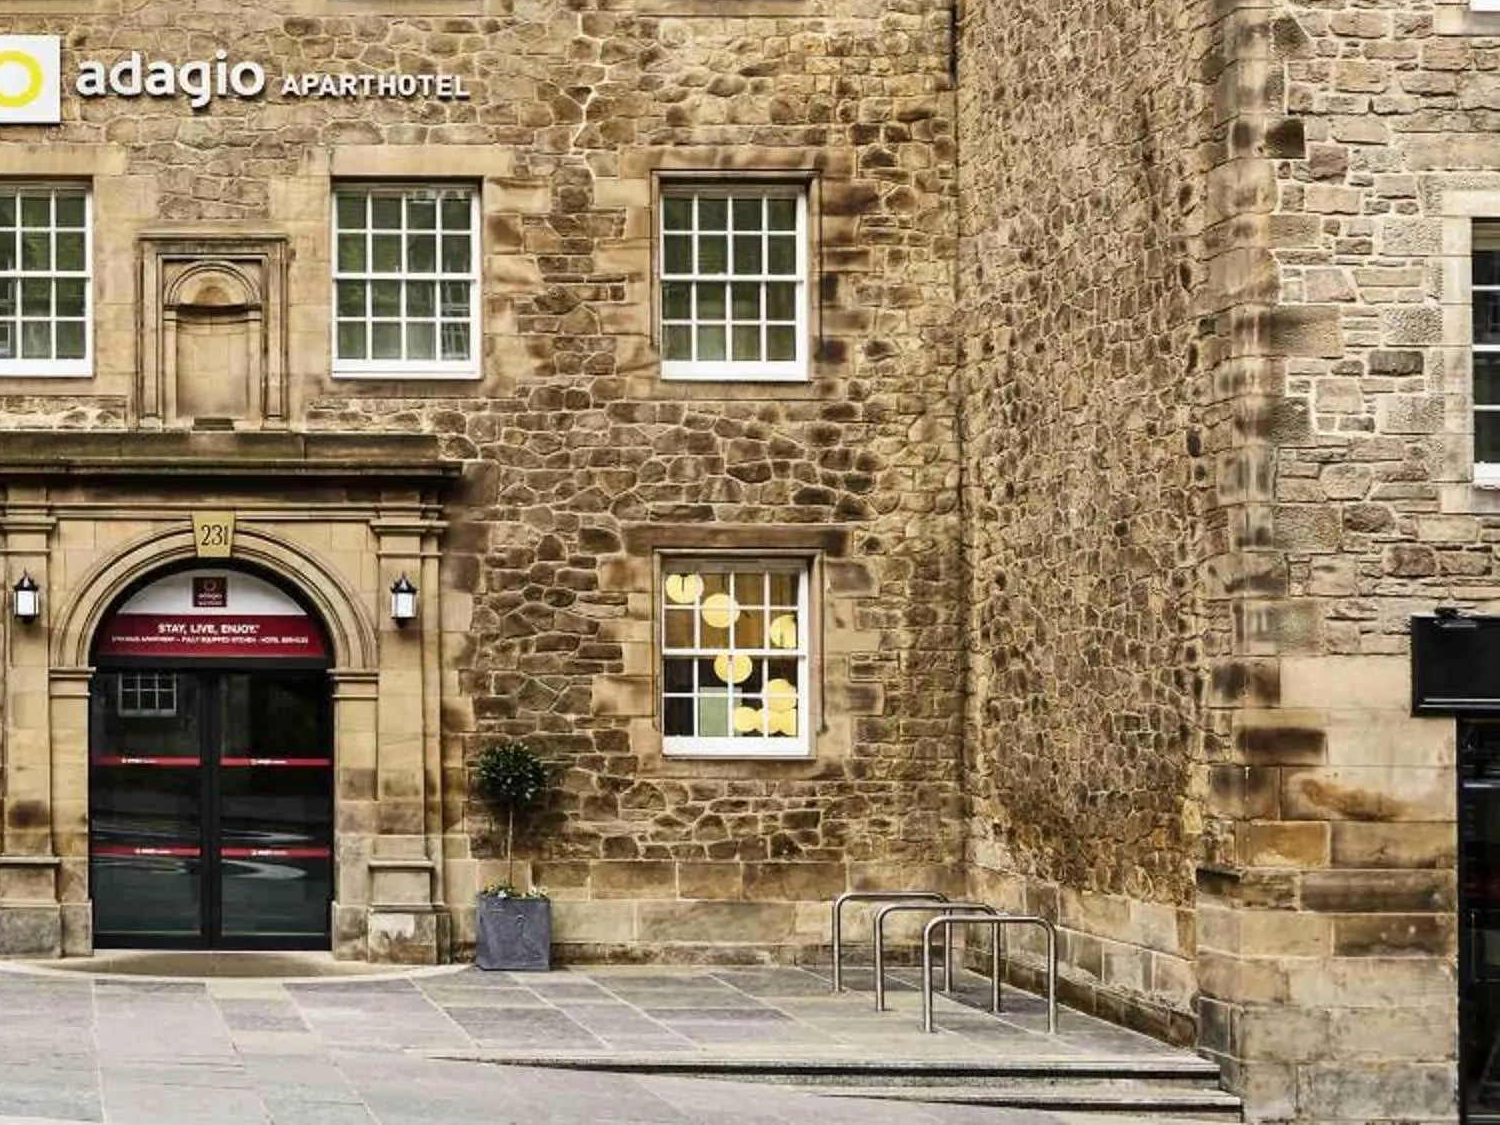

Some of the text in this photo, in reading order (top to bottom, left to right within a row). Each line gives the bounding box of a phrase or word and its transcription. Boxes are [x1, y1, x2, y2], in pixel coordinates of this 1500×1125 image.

[76, 49, 470, 108] adagio APARTHOTEL
[200, 524, 229, 546] 231
[157, 623, 187, 635] STAY,
[189, 623, 218, 635] LIVE,
